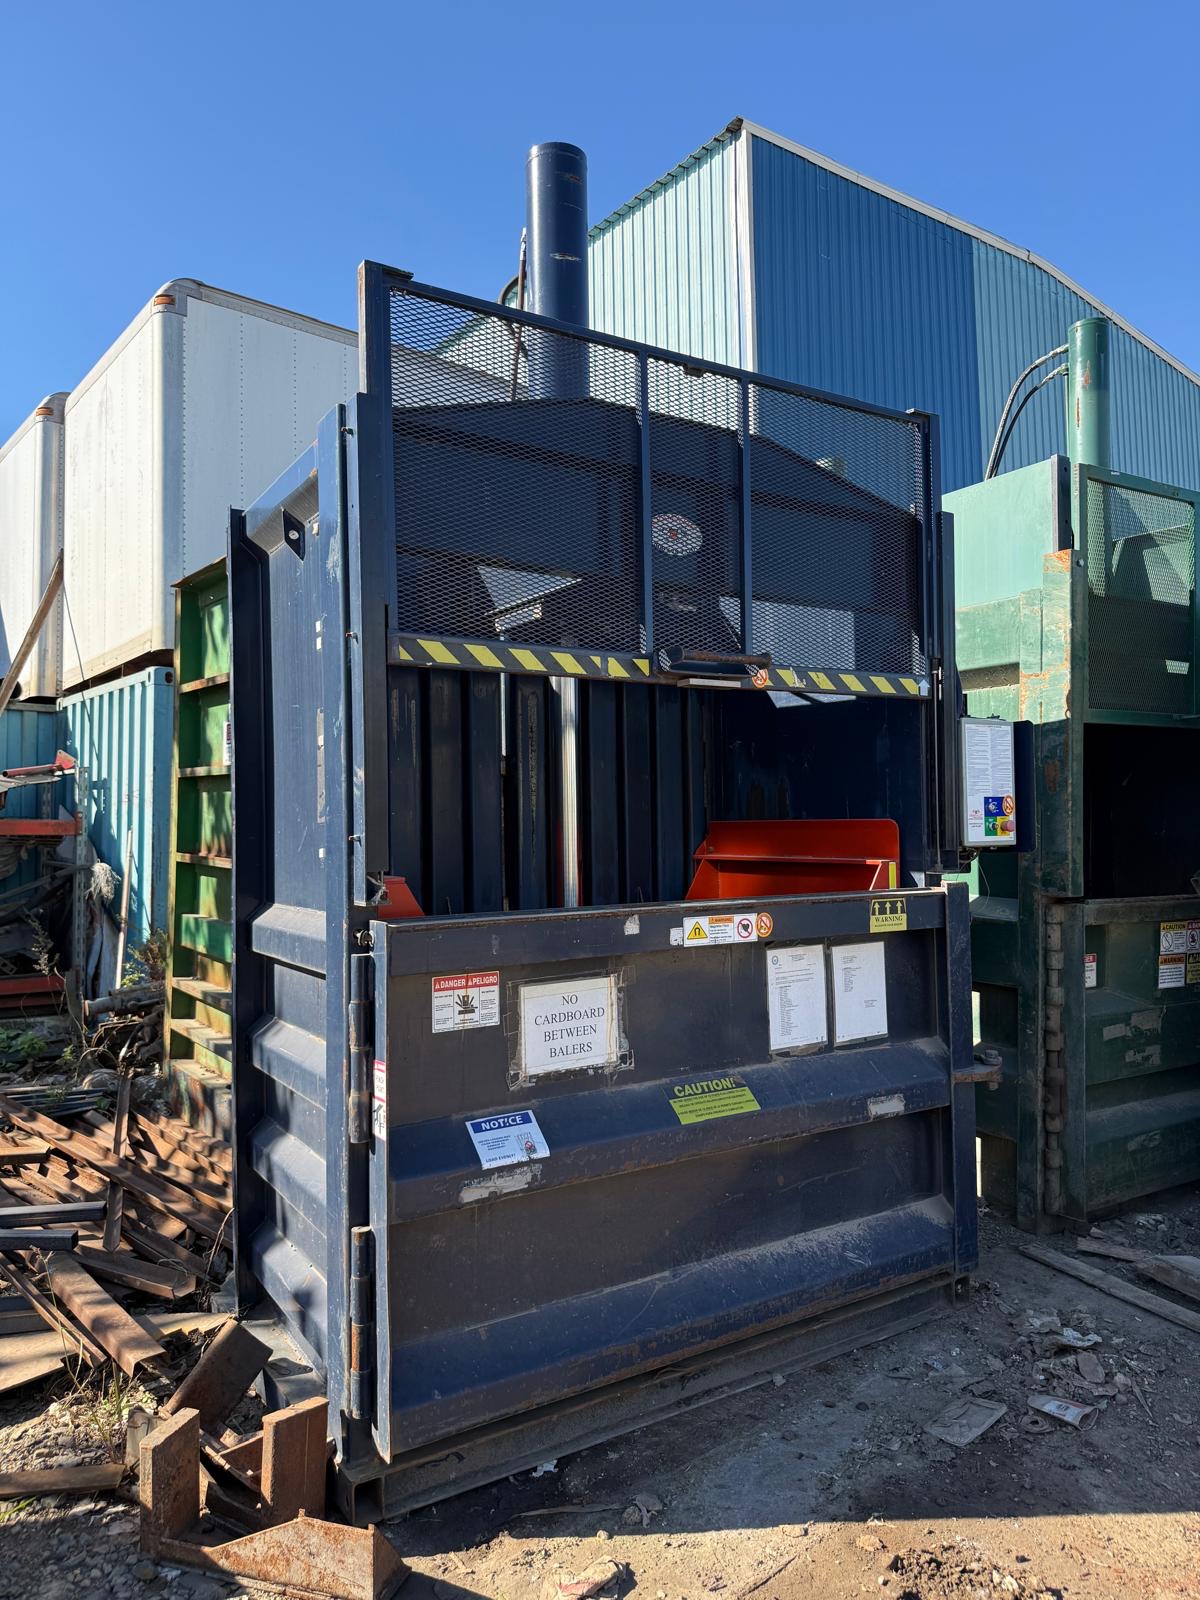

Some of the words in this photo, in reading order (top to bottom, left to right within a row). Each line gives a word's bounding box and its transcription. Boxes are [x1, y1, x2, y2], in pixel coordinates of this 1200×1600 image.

[875, 914, 903, 923] WARNING
[440, 979, 466, 989] DANGER
[472, 975, 498, 986] PELIGRO
[562, 994, 579, 1006] NO
[534, 1007, 605, 1026] CARDBOARD
[543, 1024, 598, 1042] BETWEEN
[549, 1042, 593, 1058] BALERS
[674, 1078, 736, 1097] CAUTION!
